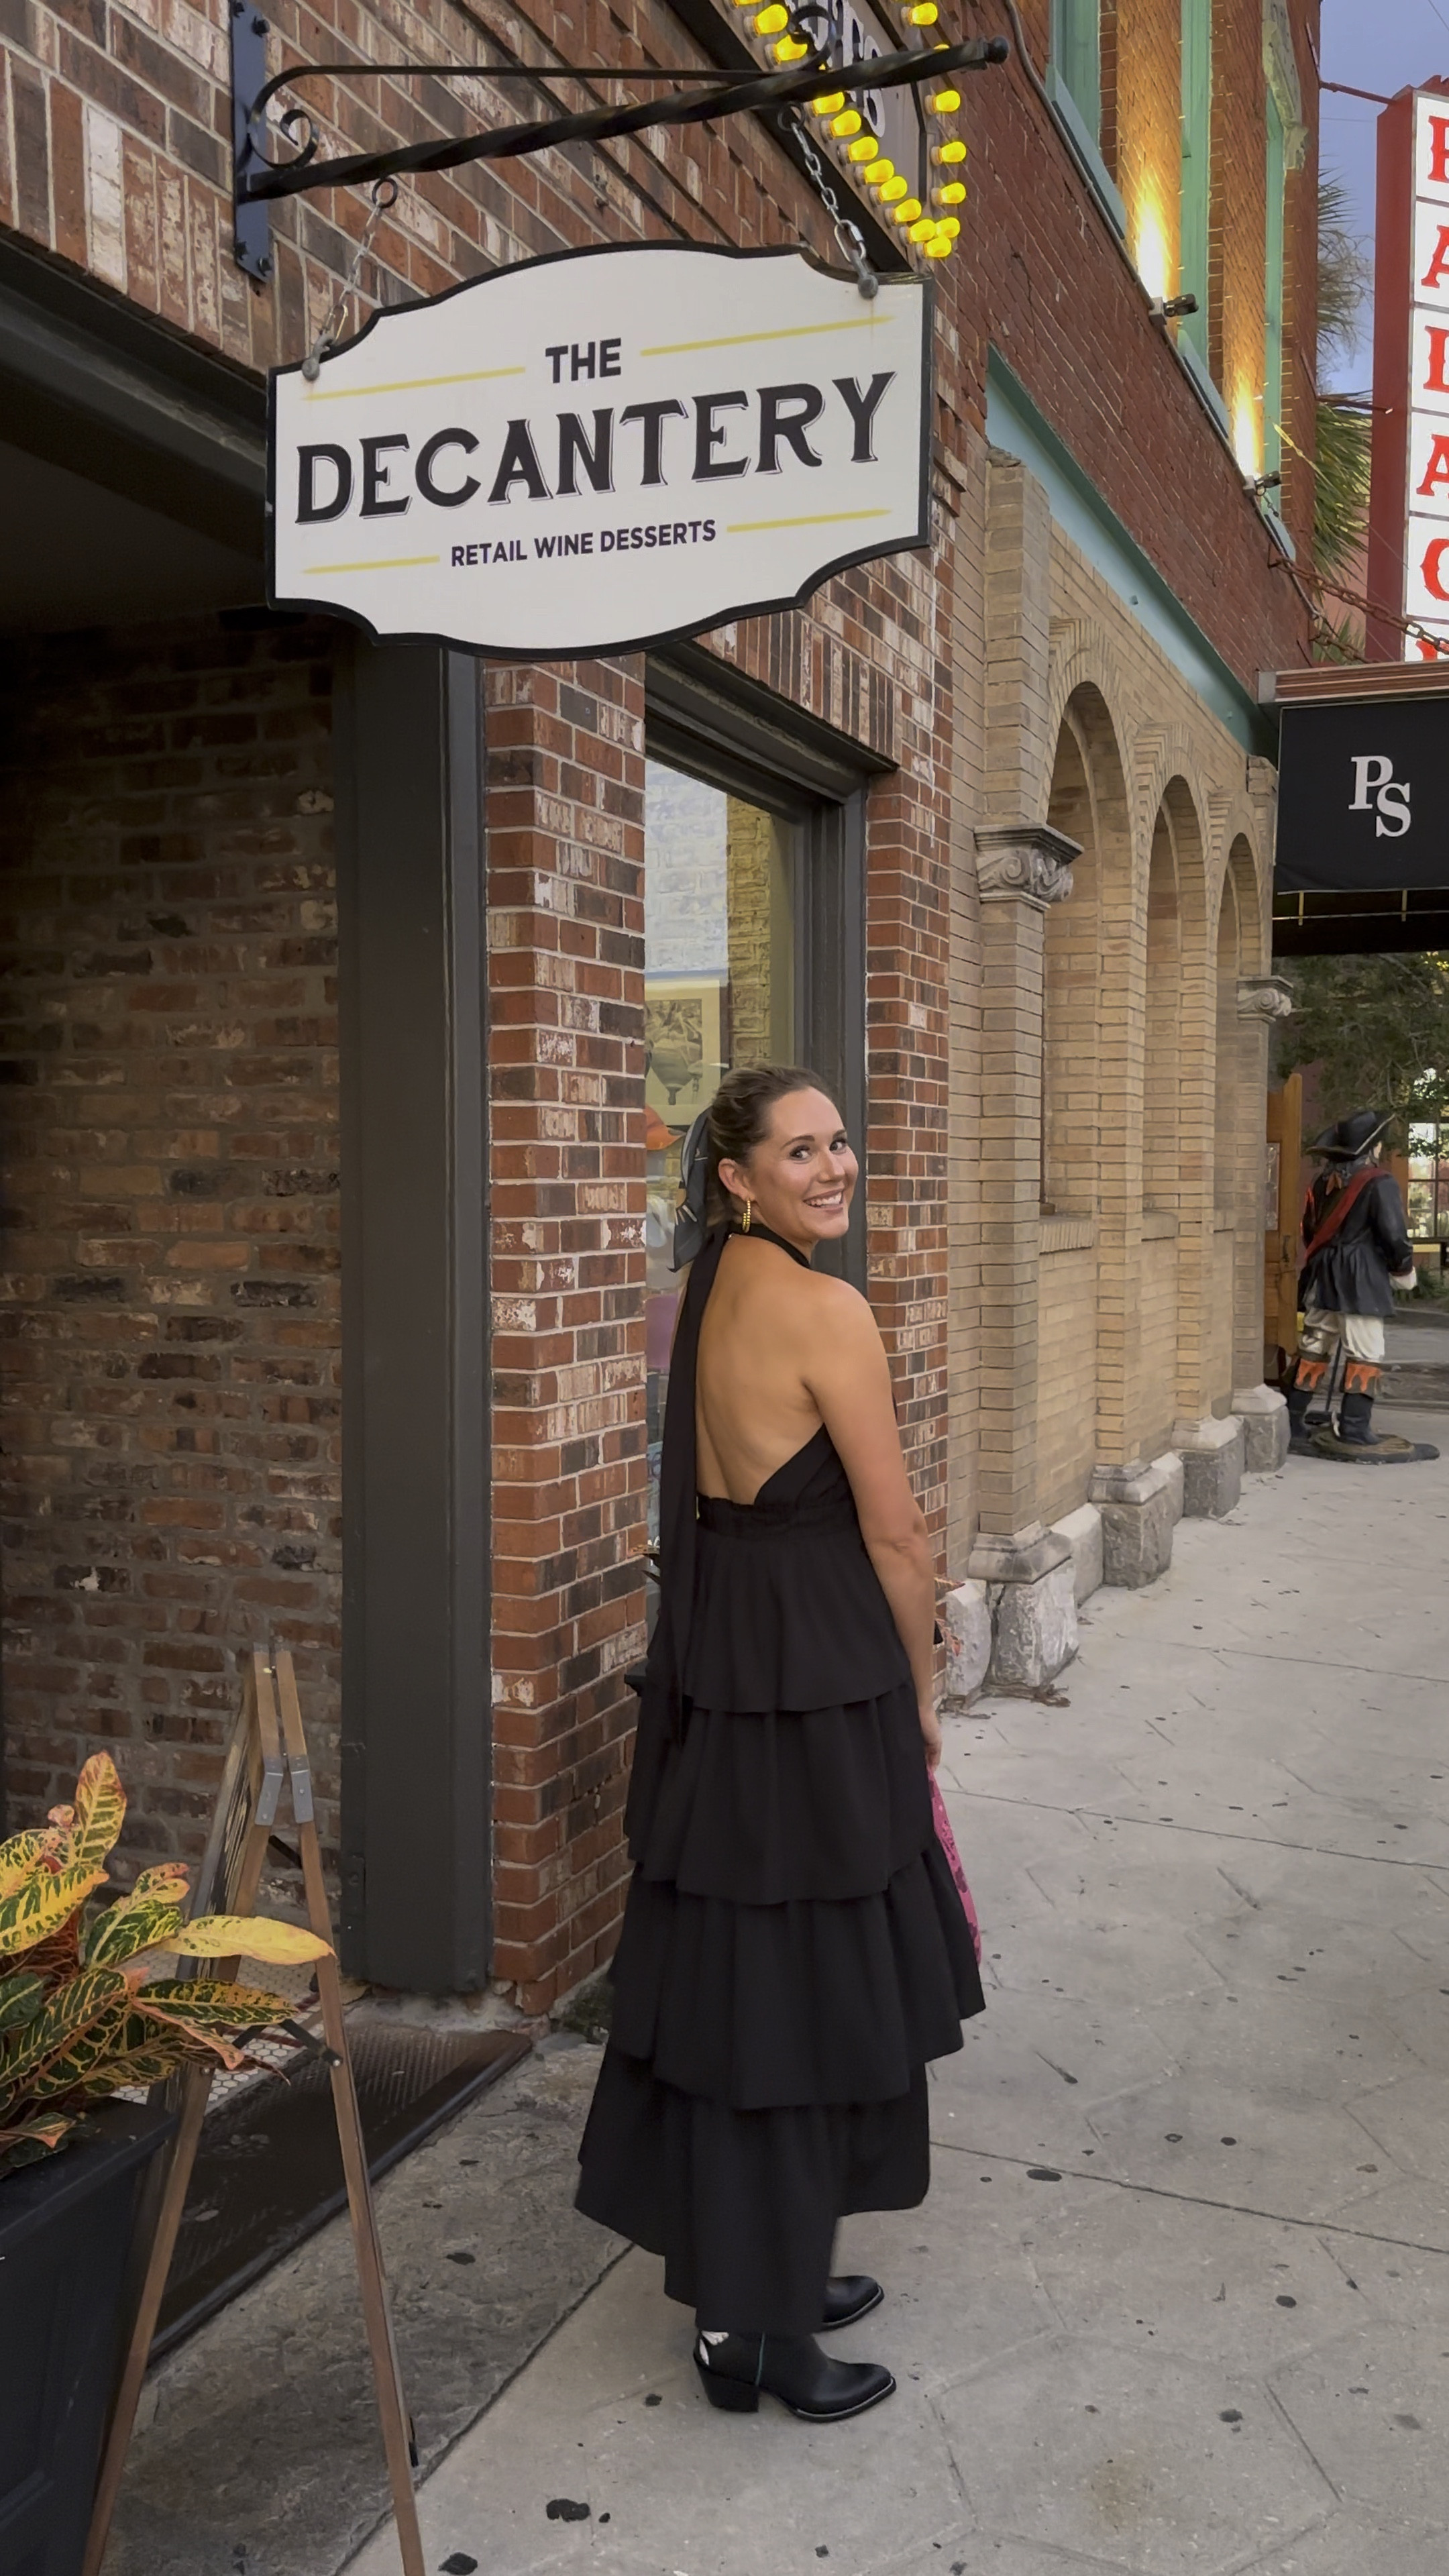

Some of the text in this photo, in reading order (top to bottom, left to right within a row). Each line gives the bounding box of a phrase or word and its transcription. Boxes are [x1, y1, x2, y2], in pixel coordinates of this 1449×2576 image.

[545, 338, 621, 383] THE
[295, 372, 897, 525] DECANTERY
[452, 520, 716, 566] RETAIL WINE DESSERTS
[1348, 756, 1411, 837] PS
